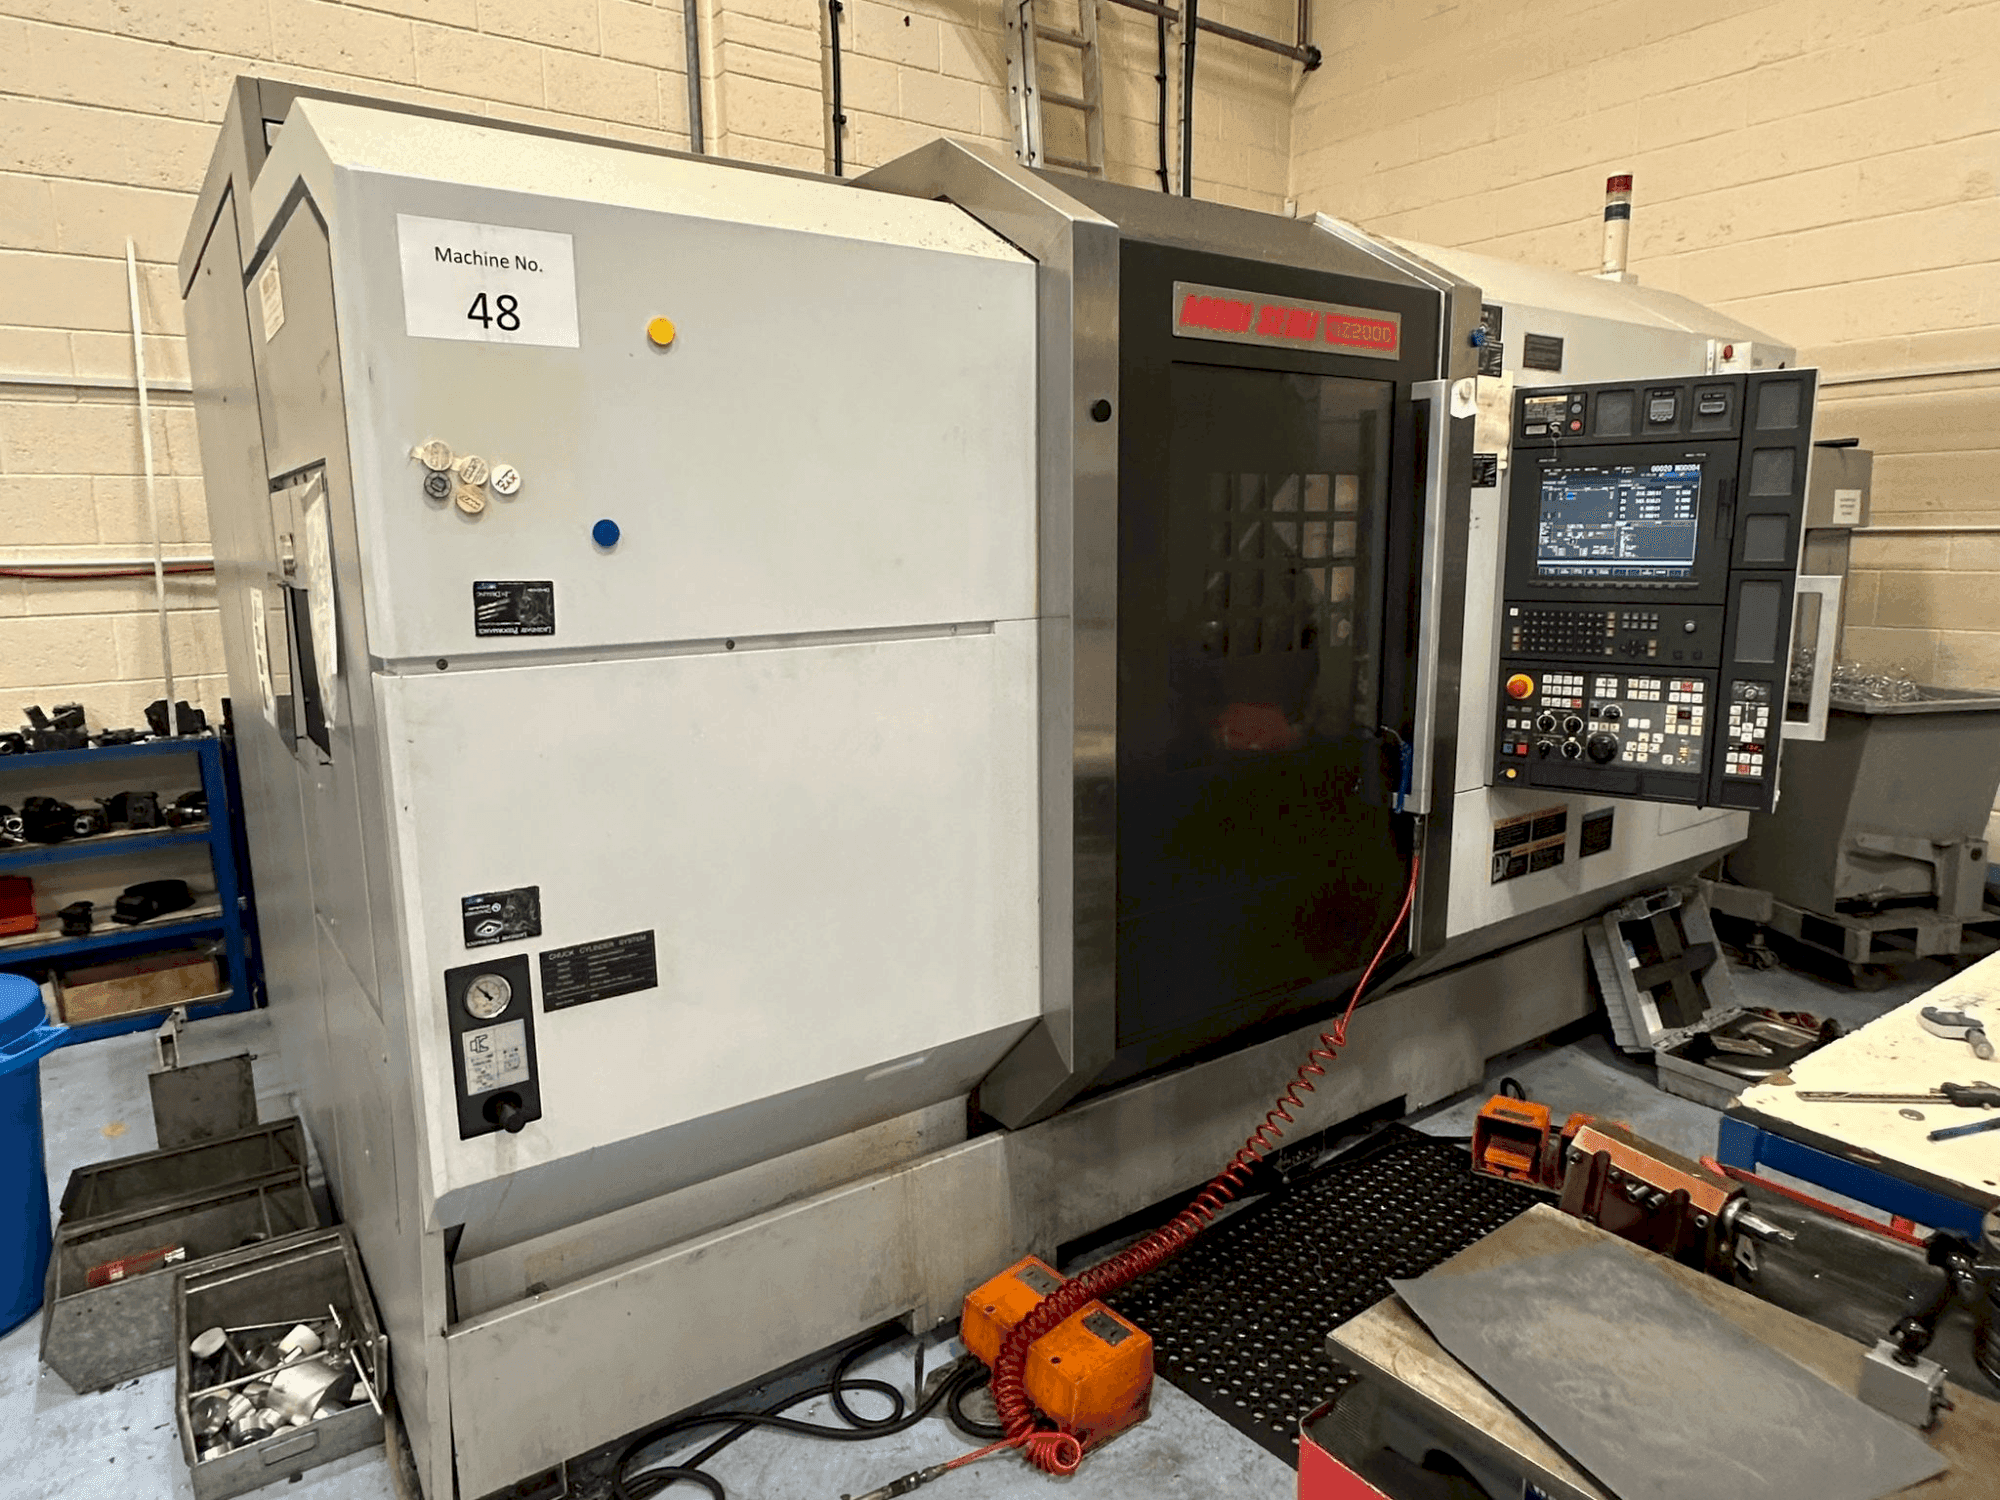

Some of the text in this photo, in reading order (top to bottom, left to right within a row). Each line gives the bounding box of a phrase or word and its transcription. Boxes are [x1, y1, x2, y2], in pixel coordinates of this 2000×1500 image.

[434, 246, 543, 273] Machine No.
[467, 292, 521, 332] 48
[548, 949, 575, 961] CHUCK
[579, 941, 615, 954] CYLINDER
